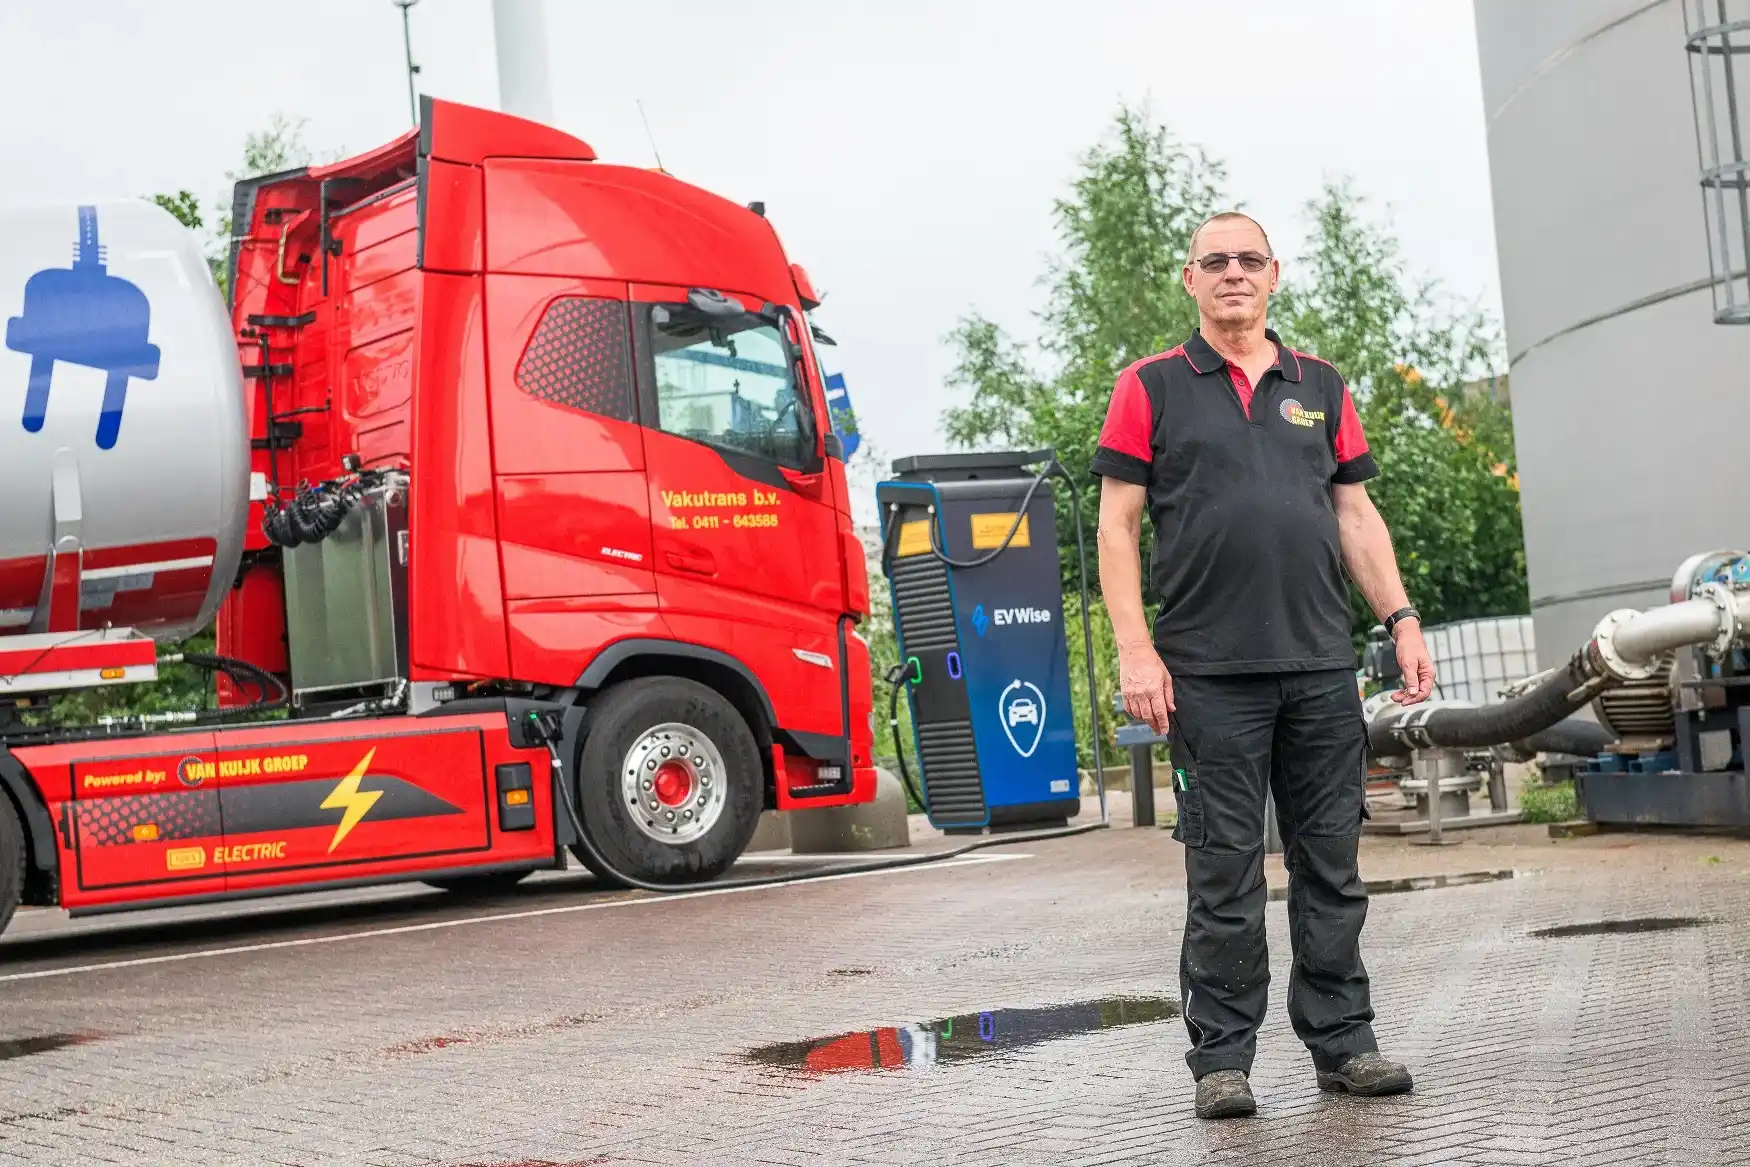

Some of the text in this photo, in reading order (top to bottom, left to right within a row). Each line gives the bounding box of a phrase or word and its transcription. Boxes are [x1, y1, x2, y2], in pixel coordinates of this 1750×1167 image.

[661, 488, 781, 507] Vakutrans b.v.
[671, 516, 689, 529] Tel.
[693, 515, 719, 529] 0411
[994, 607, 1051, 625] EV Wise
[185, 755, 308, 781] VAN KUIJK GROEP
[84, 769, 166, 788] Powered by:
[213, 841, 287, 864] ELECTRIC
